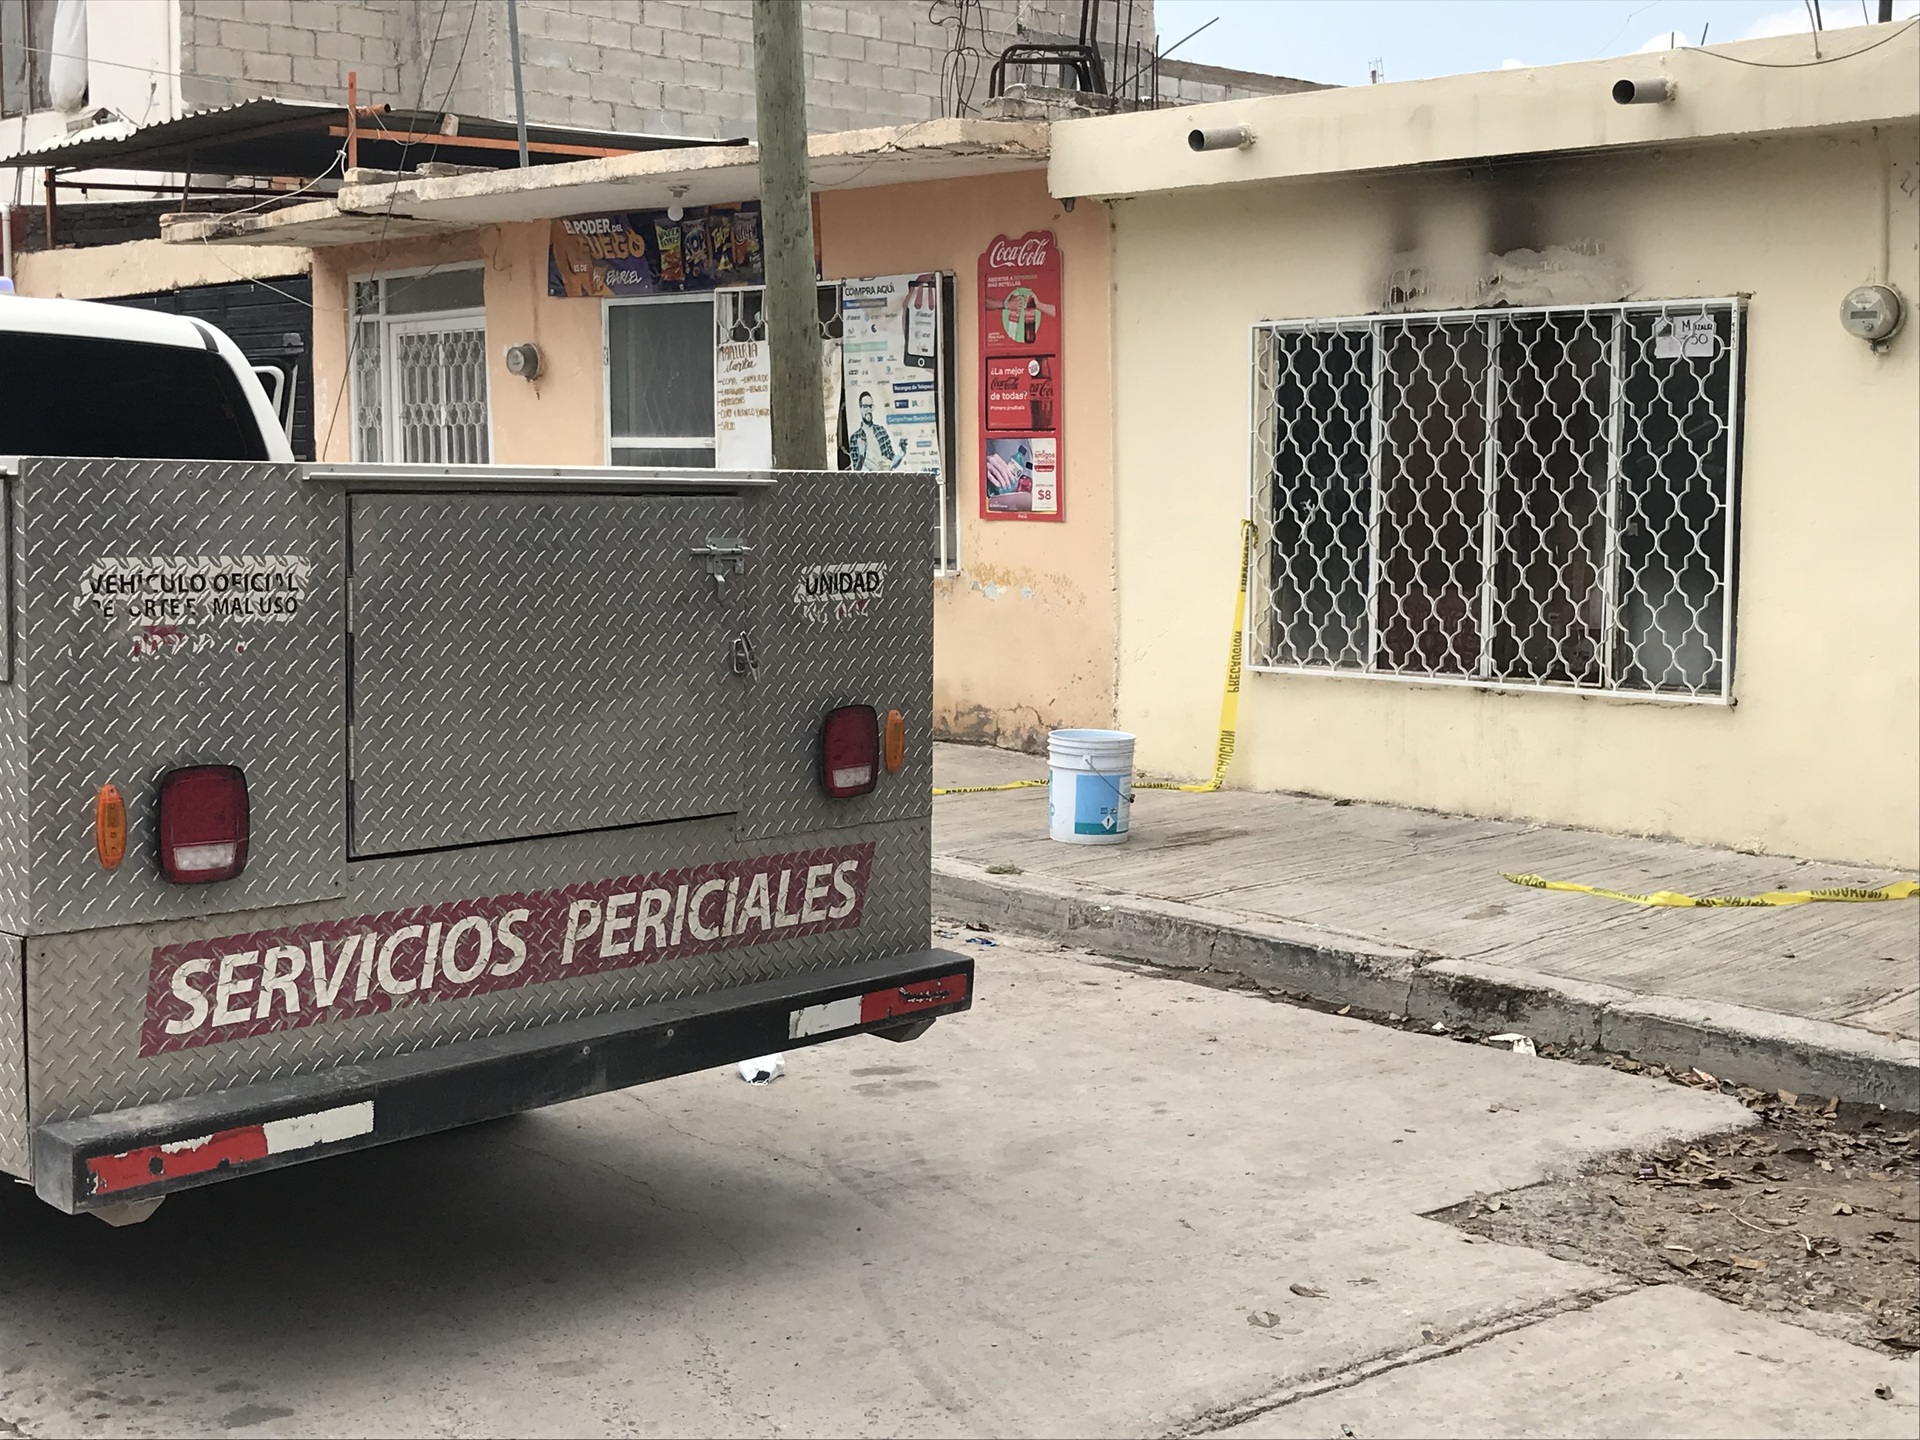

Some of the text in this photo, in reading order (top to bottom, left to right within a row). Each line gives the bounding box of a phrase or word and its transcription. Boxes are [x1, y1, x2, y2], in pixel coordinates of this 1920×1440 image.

[574, 218, 611, 235] PODER
[845, 286, 876, 297] COMPRA
[991, 367, 1004, 376] ¿La
[1004, 366, 1025, 377] mejor
[990, 390, 1028, 401] de todas?
[1037, 488, 1052, 501] $8
[806, 571, 880, 595] UNIDAD
[213, 597, 254, 616] MAL
[259, 596, 298, 614] USO
[163, 858, 859, 1036] SERVICIOS PERICIALES
